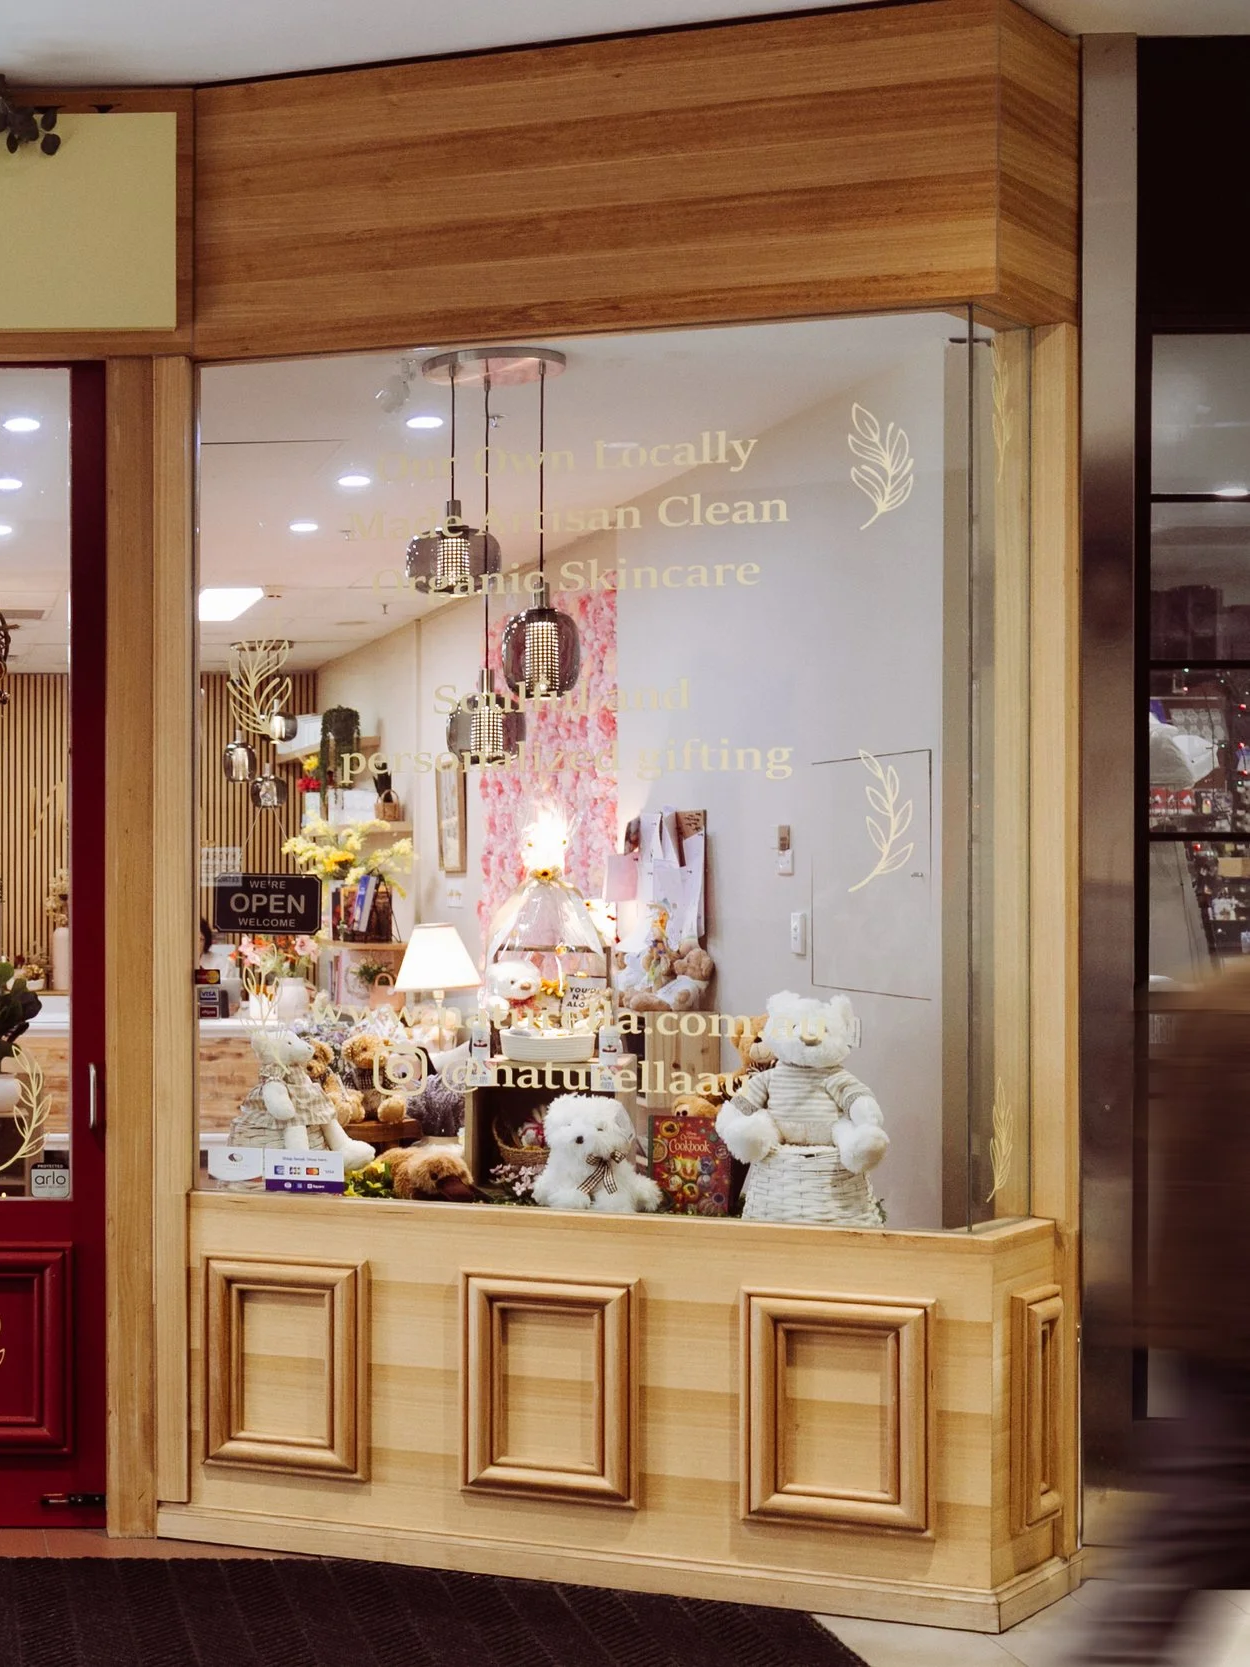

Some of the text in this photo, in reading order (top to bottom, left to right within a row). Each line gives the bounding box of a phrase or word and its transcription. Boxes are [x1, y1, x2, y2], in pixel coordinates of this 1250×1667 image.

[377, 431, 758, 481] Our Own Locally
[347, 494, 790, 541] Made Artisan Clean
[372, 559, 762, 598] Organic Skincare
[433, 677, 691, 715] Soulful and
[340, 738, 795, 784] personalized gifting
[230, 893, 305, 914] OPEN
[250, 880, 286, 889] WE'RE
[238, 917, 295, 927] WELCOME
[312, 998, 829, 1040] wwwnaturella.com.au
[669, 1139, 711, 1154] Cookbook
[34, 1171, 67, 1185] arlo
